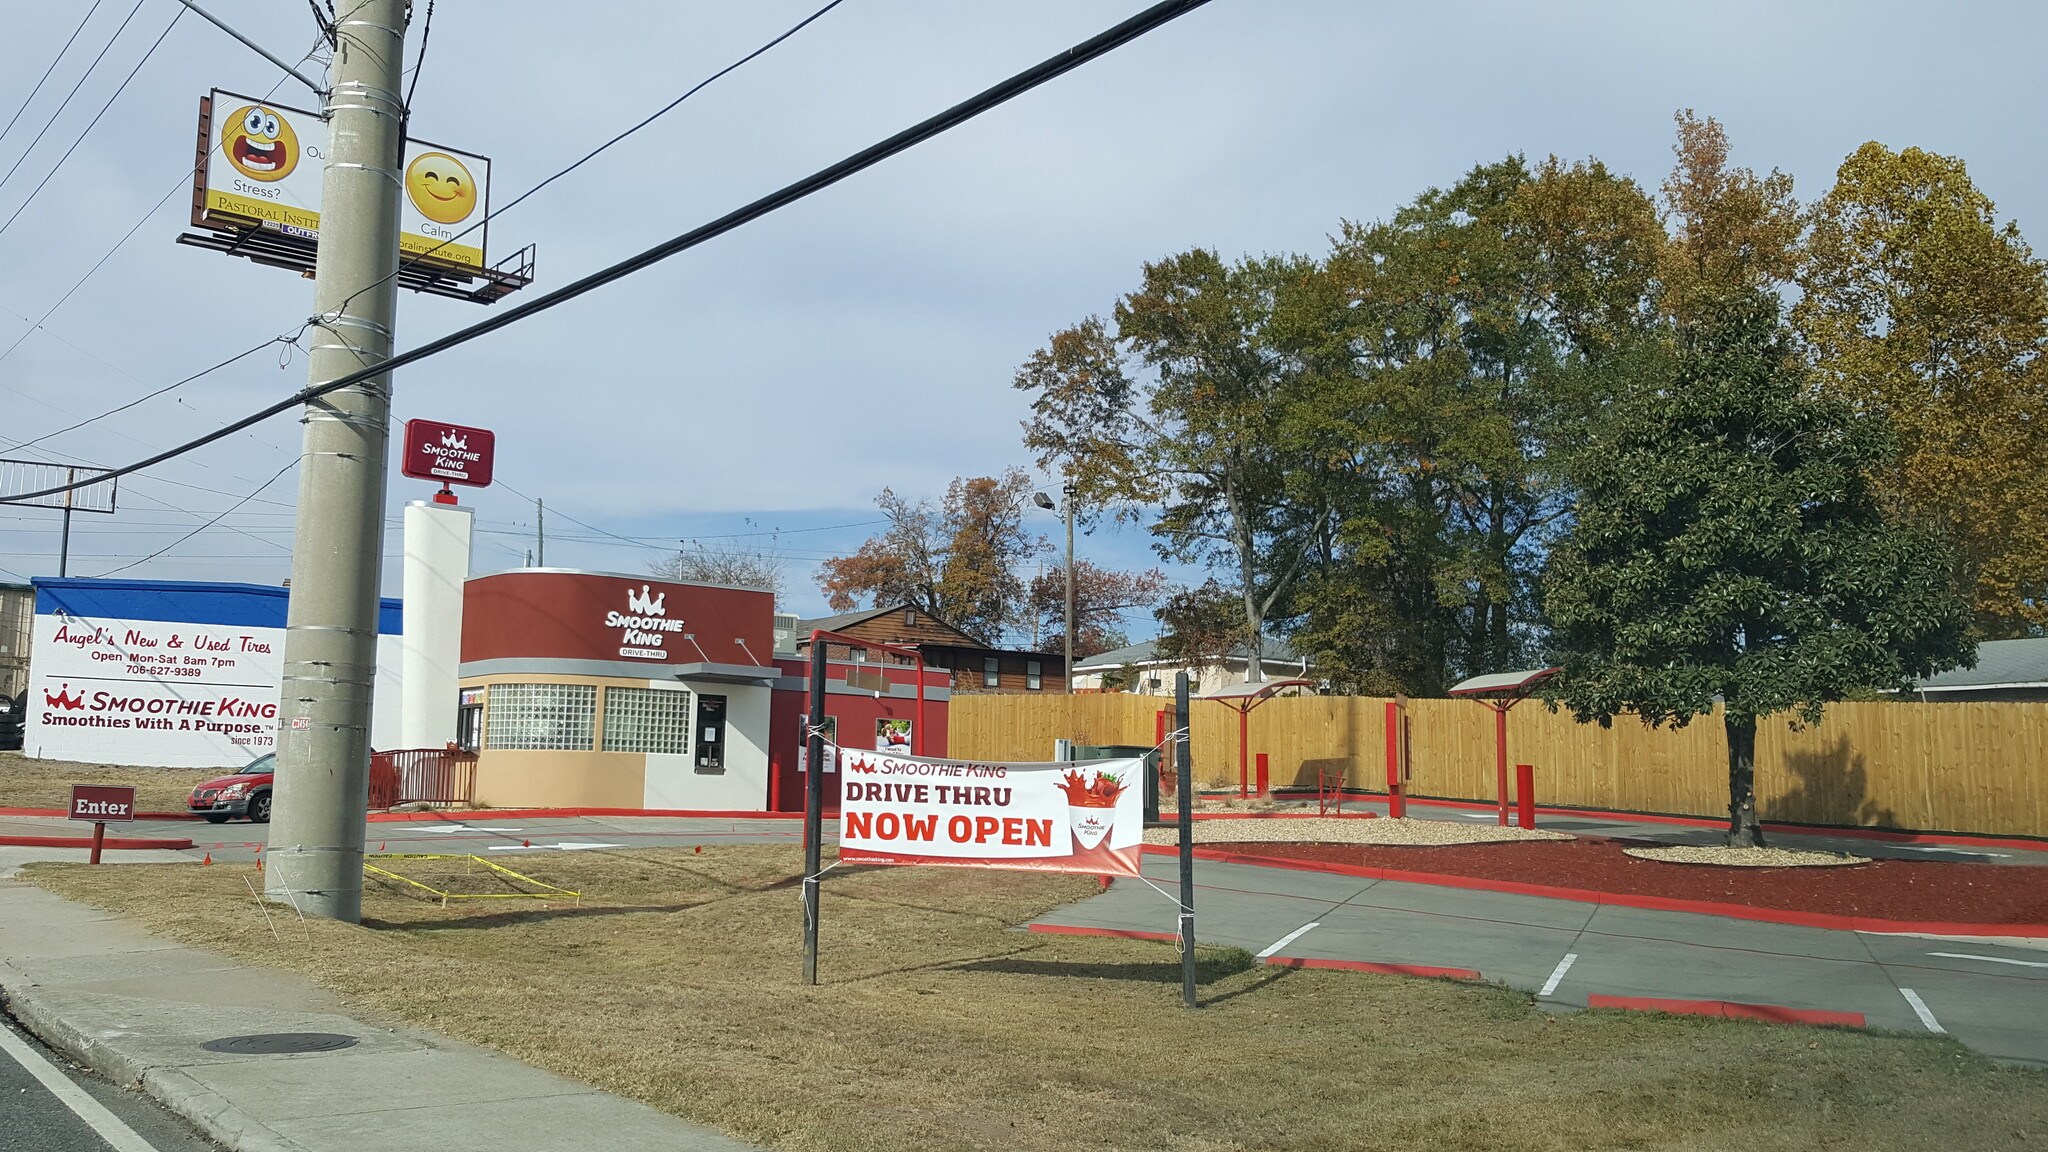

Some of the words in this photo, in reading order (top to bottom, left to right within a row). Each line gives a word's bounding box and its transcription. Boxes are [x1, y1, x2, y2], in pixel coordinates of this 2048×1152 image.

[233, 180, 281, 199] Stress?
[218, 197, 279, 220] PASTORAL
[287, 226, 320, 239] OUTFR
[421, 223, 452, 239] Calm
[422, 443, 480, 461] SMOOTHIE
[433, 469, 467, 478] DRIVE-THRU
[605, 611, 684, 632] SMOOTHIE
[53, 625, 115, 649] Angel's
[124, 629, 158, 648] New
[167, 634, 184, 648] &
[194, 635, 230, 652] Used
[239, 636, 271, 654] Tires
[91, 651, 122, 663] Open
[129, 653, 177, 664] Mon-Sat
[183, 656, 207, 666] 8am
[211, 657, 235, 667] 7pm
[622, 649, 666, 658] DRIVE-THRU
[126, 665, 201, 677] 706-627-9389
[89, 691, 215, 716] SMOOTHIE
[41, 712, 130, 729] Smoothies
[135, 717, 173, 730] With
[178, 718, 191, 731] A
[230, 736, 251, 746] since
[253, 736, 274, 746] 1973
[880, 759, 964, 777] SMOOTHIE
[846, 782, 929, 804] DRIVE
[935, 785, 1012, 807] THRU
[75, 799, 128, 815] Enter
[845, 812, 939, 842] NOW
[948, 815, 1053, 847] OPEN
